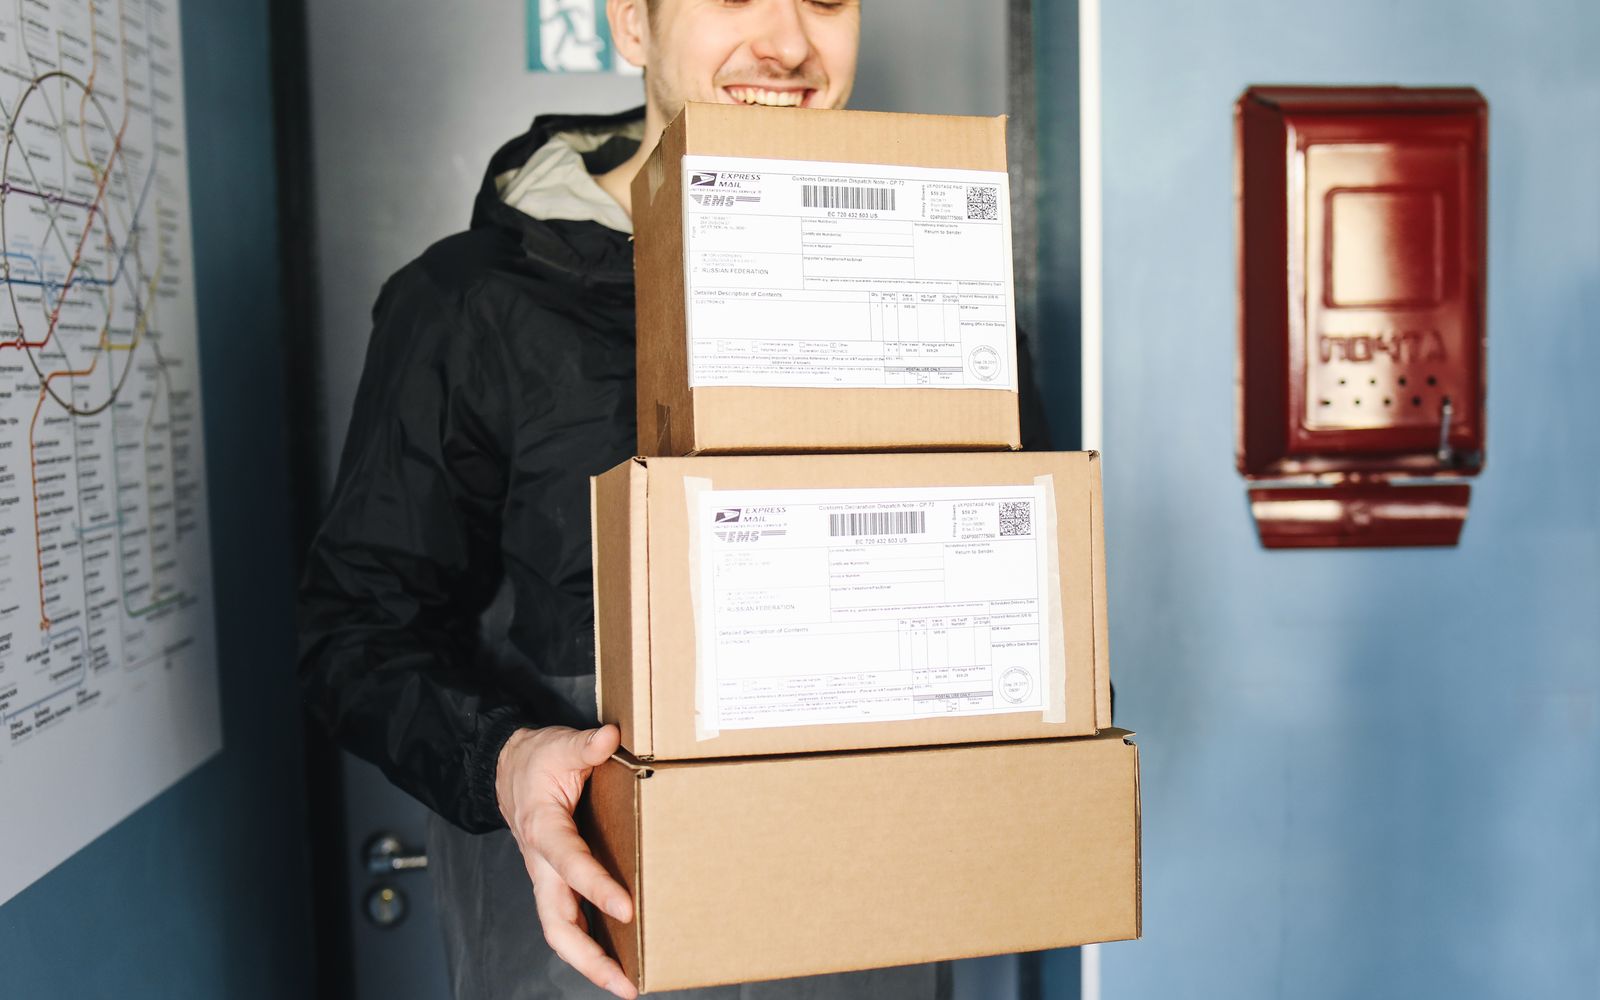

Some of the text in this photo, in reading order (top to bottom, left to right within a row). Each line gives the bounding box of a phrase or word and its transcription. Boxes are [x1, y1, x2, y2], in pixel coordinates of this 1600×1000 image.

[720, 172, 761, 181] EXPRESS
[702, 194, 734, 207] EMS
[1320, 331, 1447, 364] ПОЧТА
[727, 530, 760, 544] EMS
